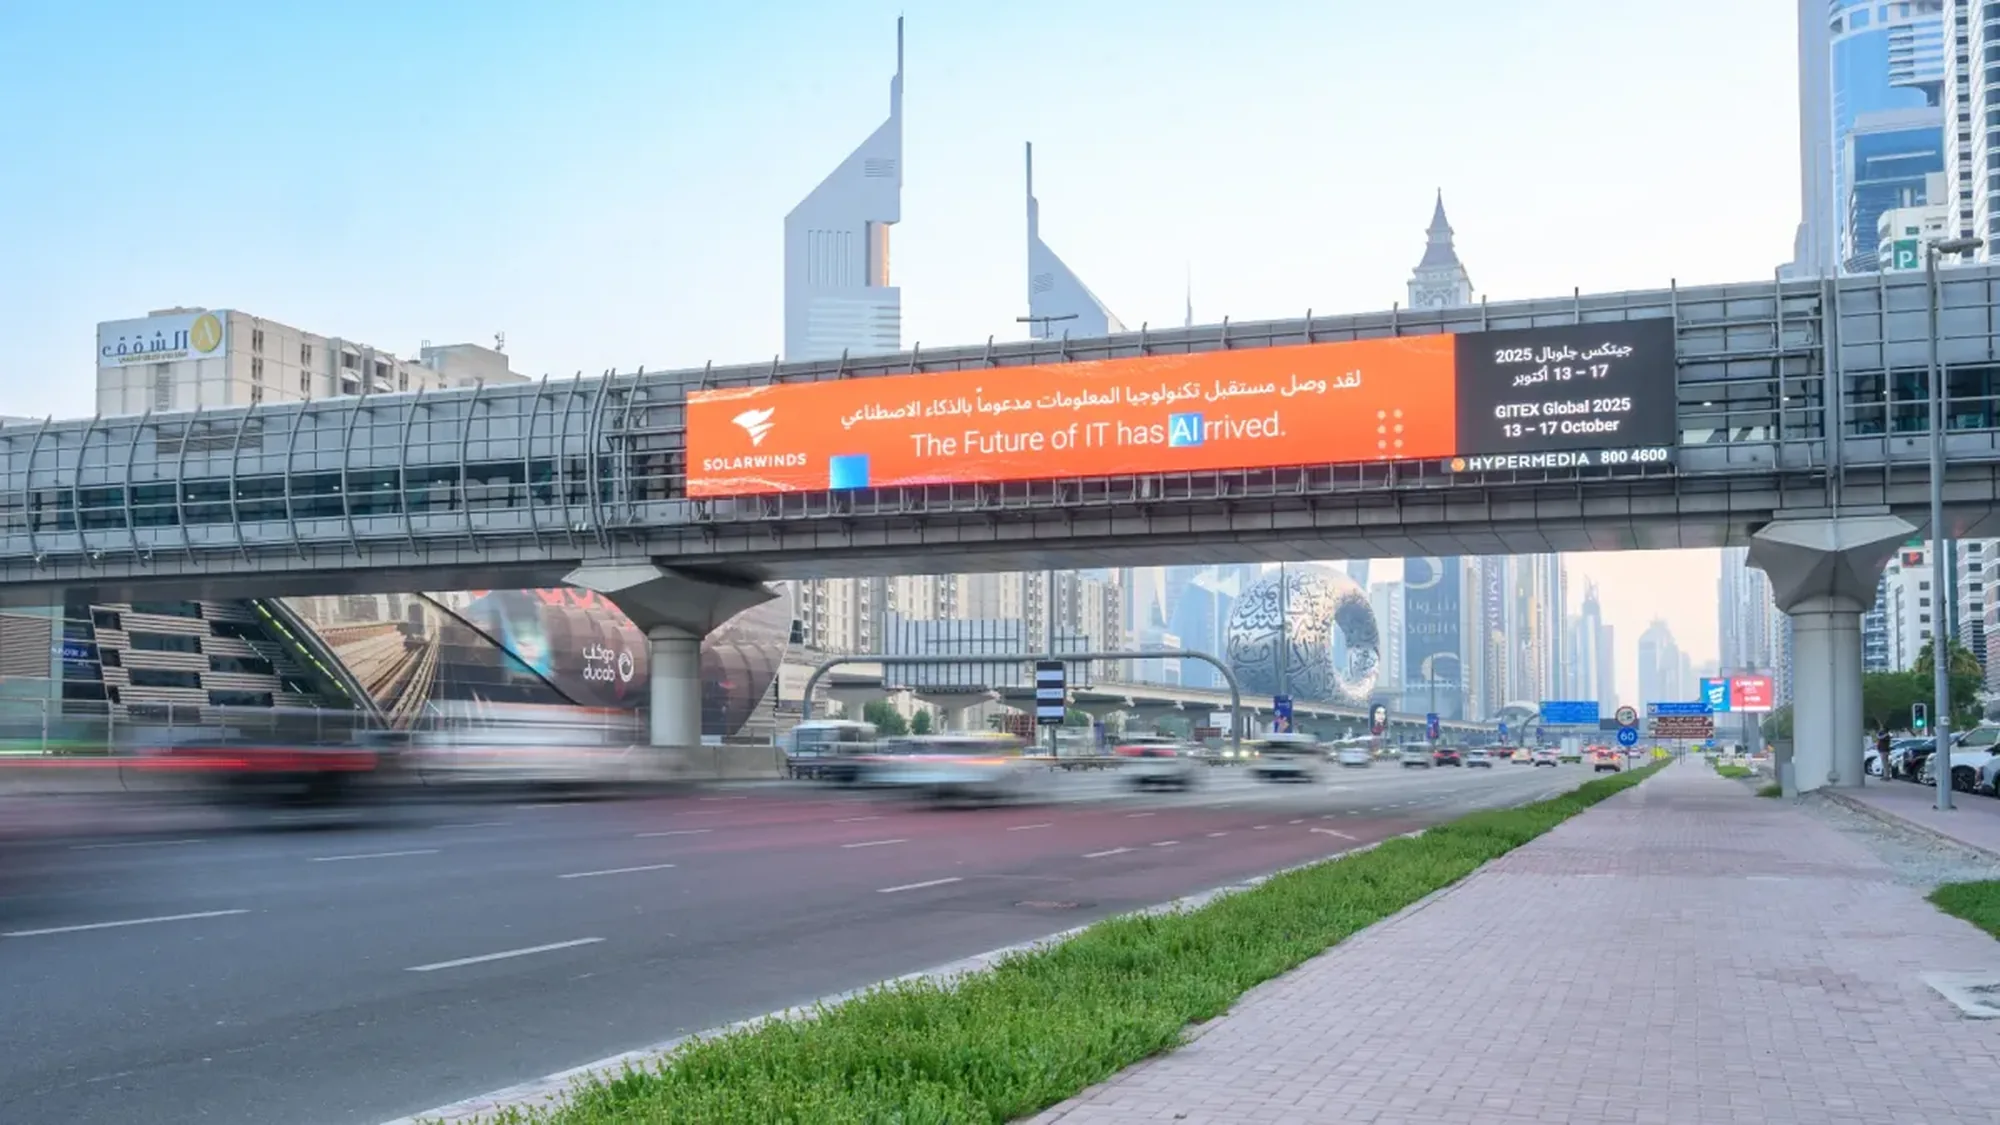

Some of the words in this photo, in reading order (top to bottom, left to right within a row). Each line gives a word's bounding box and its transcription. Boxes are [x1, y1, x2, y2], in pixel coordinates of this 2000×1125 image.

[1899, 250, 1913, 268] P
[1495, 347, 1533, 364] 2025
[1535, 345, 1578, 363] جلوبال
[1581, 343, 1633, 360] جيتكس
[1333, 370, 1362, 389] لقد
[1512, 365, 1549, 387] أكتوبر
[1553, 367, 1572, 381] 13
[1589, 364, 1609, 378] 17
[1126, 382, 1201, 406] تكنولوجيا
[1204, 380, 1276, 402] مستقبل
[1280, 374, 1327, 396] وصل
[925, 397, 973, 417] بالذكاء
[1036, 387, 1120, 413] المعلومات
[1495, 403, 1540, 418] GITEX
[1543, 400, 1590, 416] Global
[1593, 397, 1631, 413] 2025
[840, 401, 921, 430] الاصطناعي
[1503, 424, 1522, 437] 13
[1539, 422, 1558, 435] 17
[1561, 418, 1620, 434] October
[911, 434, 957, 458] The
[964, 430, 1044, 455] Future
[1051, 423, 1079, 450] of
[1086, 422, 1111, 448] IT
[1117, 420, 1164, 446] has
[703, 453, 807, 471] SOLARWINDS
[1469, 453, 1590, 471] HYPERMEDIA
[1601, 450, 1628, 464] 800
[1631, 448, 1667, 462] 4600
[1620, 731, 1634, 741] 60
